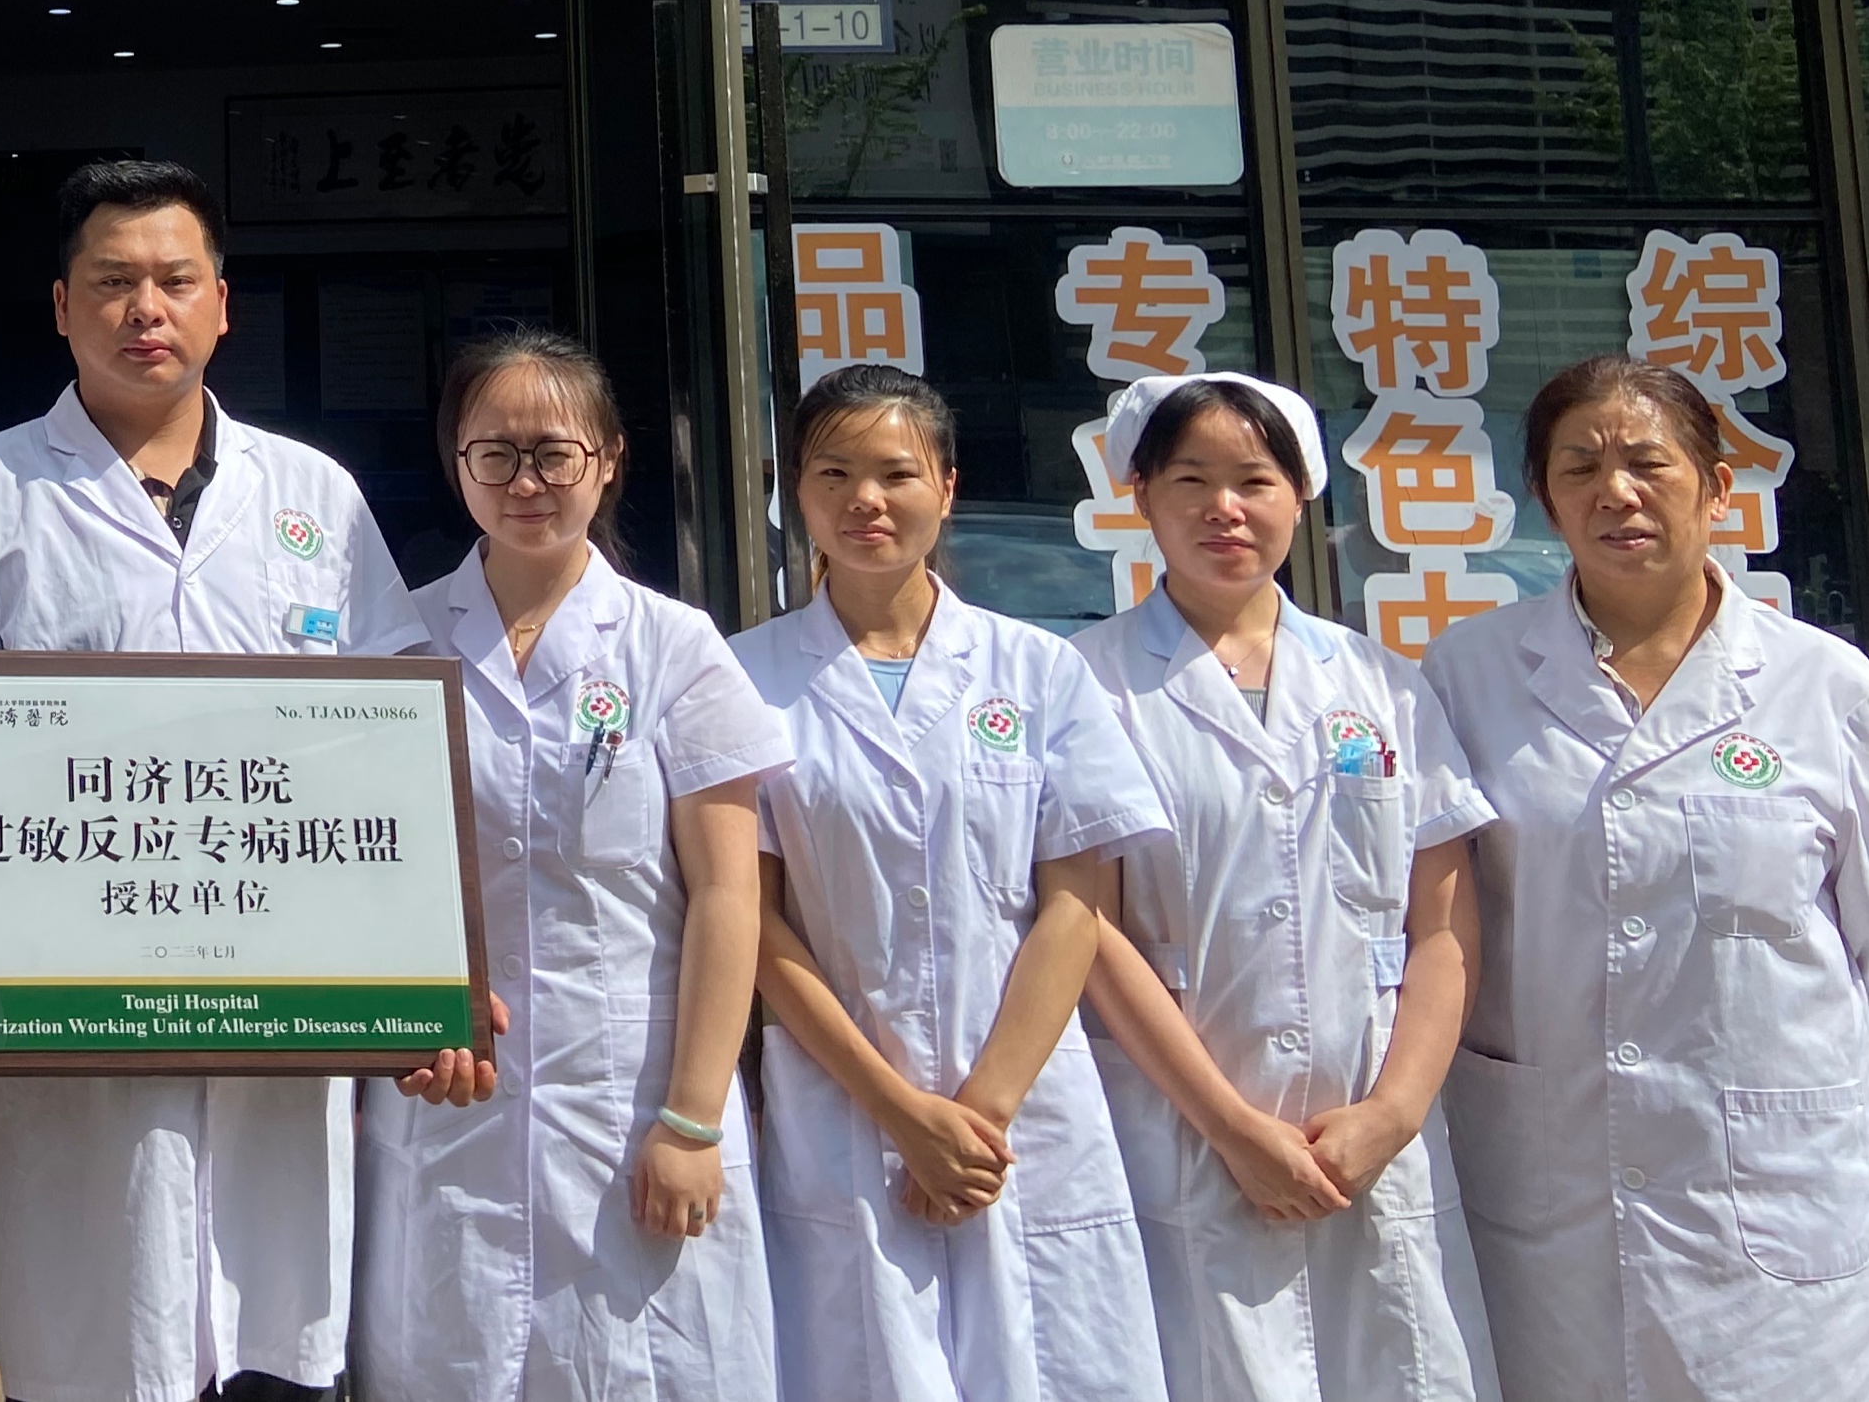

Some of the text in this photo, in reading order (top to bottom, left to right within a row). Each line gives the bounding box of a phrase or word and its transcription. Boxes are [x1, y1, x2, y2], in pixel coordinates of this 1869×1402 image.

[1031, 36, 1196, 77] 营业时间
[275, 705, 418, 720] No. TJADA30866
[66, 756, 294, 805] 同济医院
[100, 879, 272, 916] 授权单位
[121, 993, 259, 1013] Tongji Hospital
[68, 1018, 148, 1038] Working
[153, 1018, 191, 1034] Unit
[196, 1017, 216, 1034] of
[218, 1017, 289, 1038] Allergic
[292, 1017, 368, 1035] Diseases
[371, 1017, 444, 1035] Alliance
